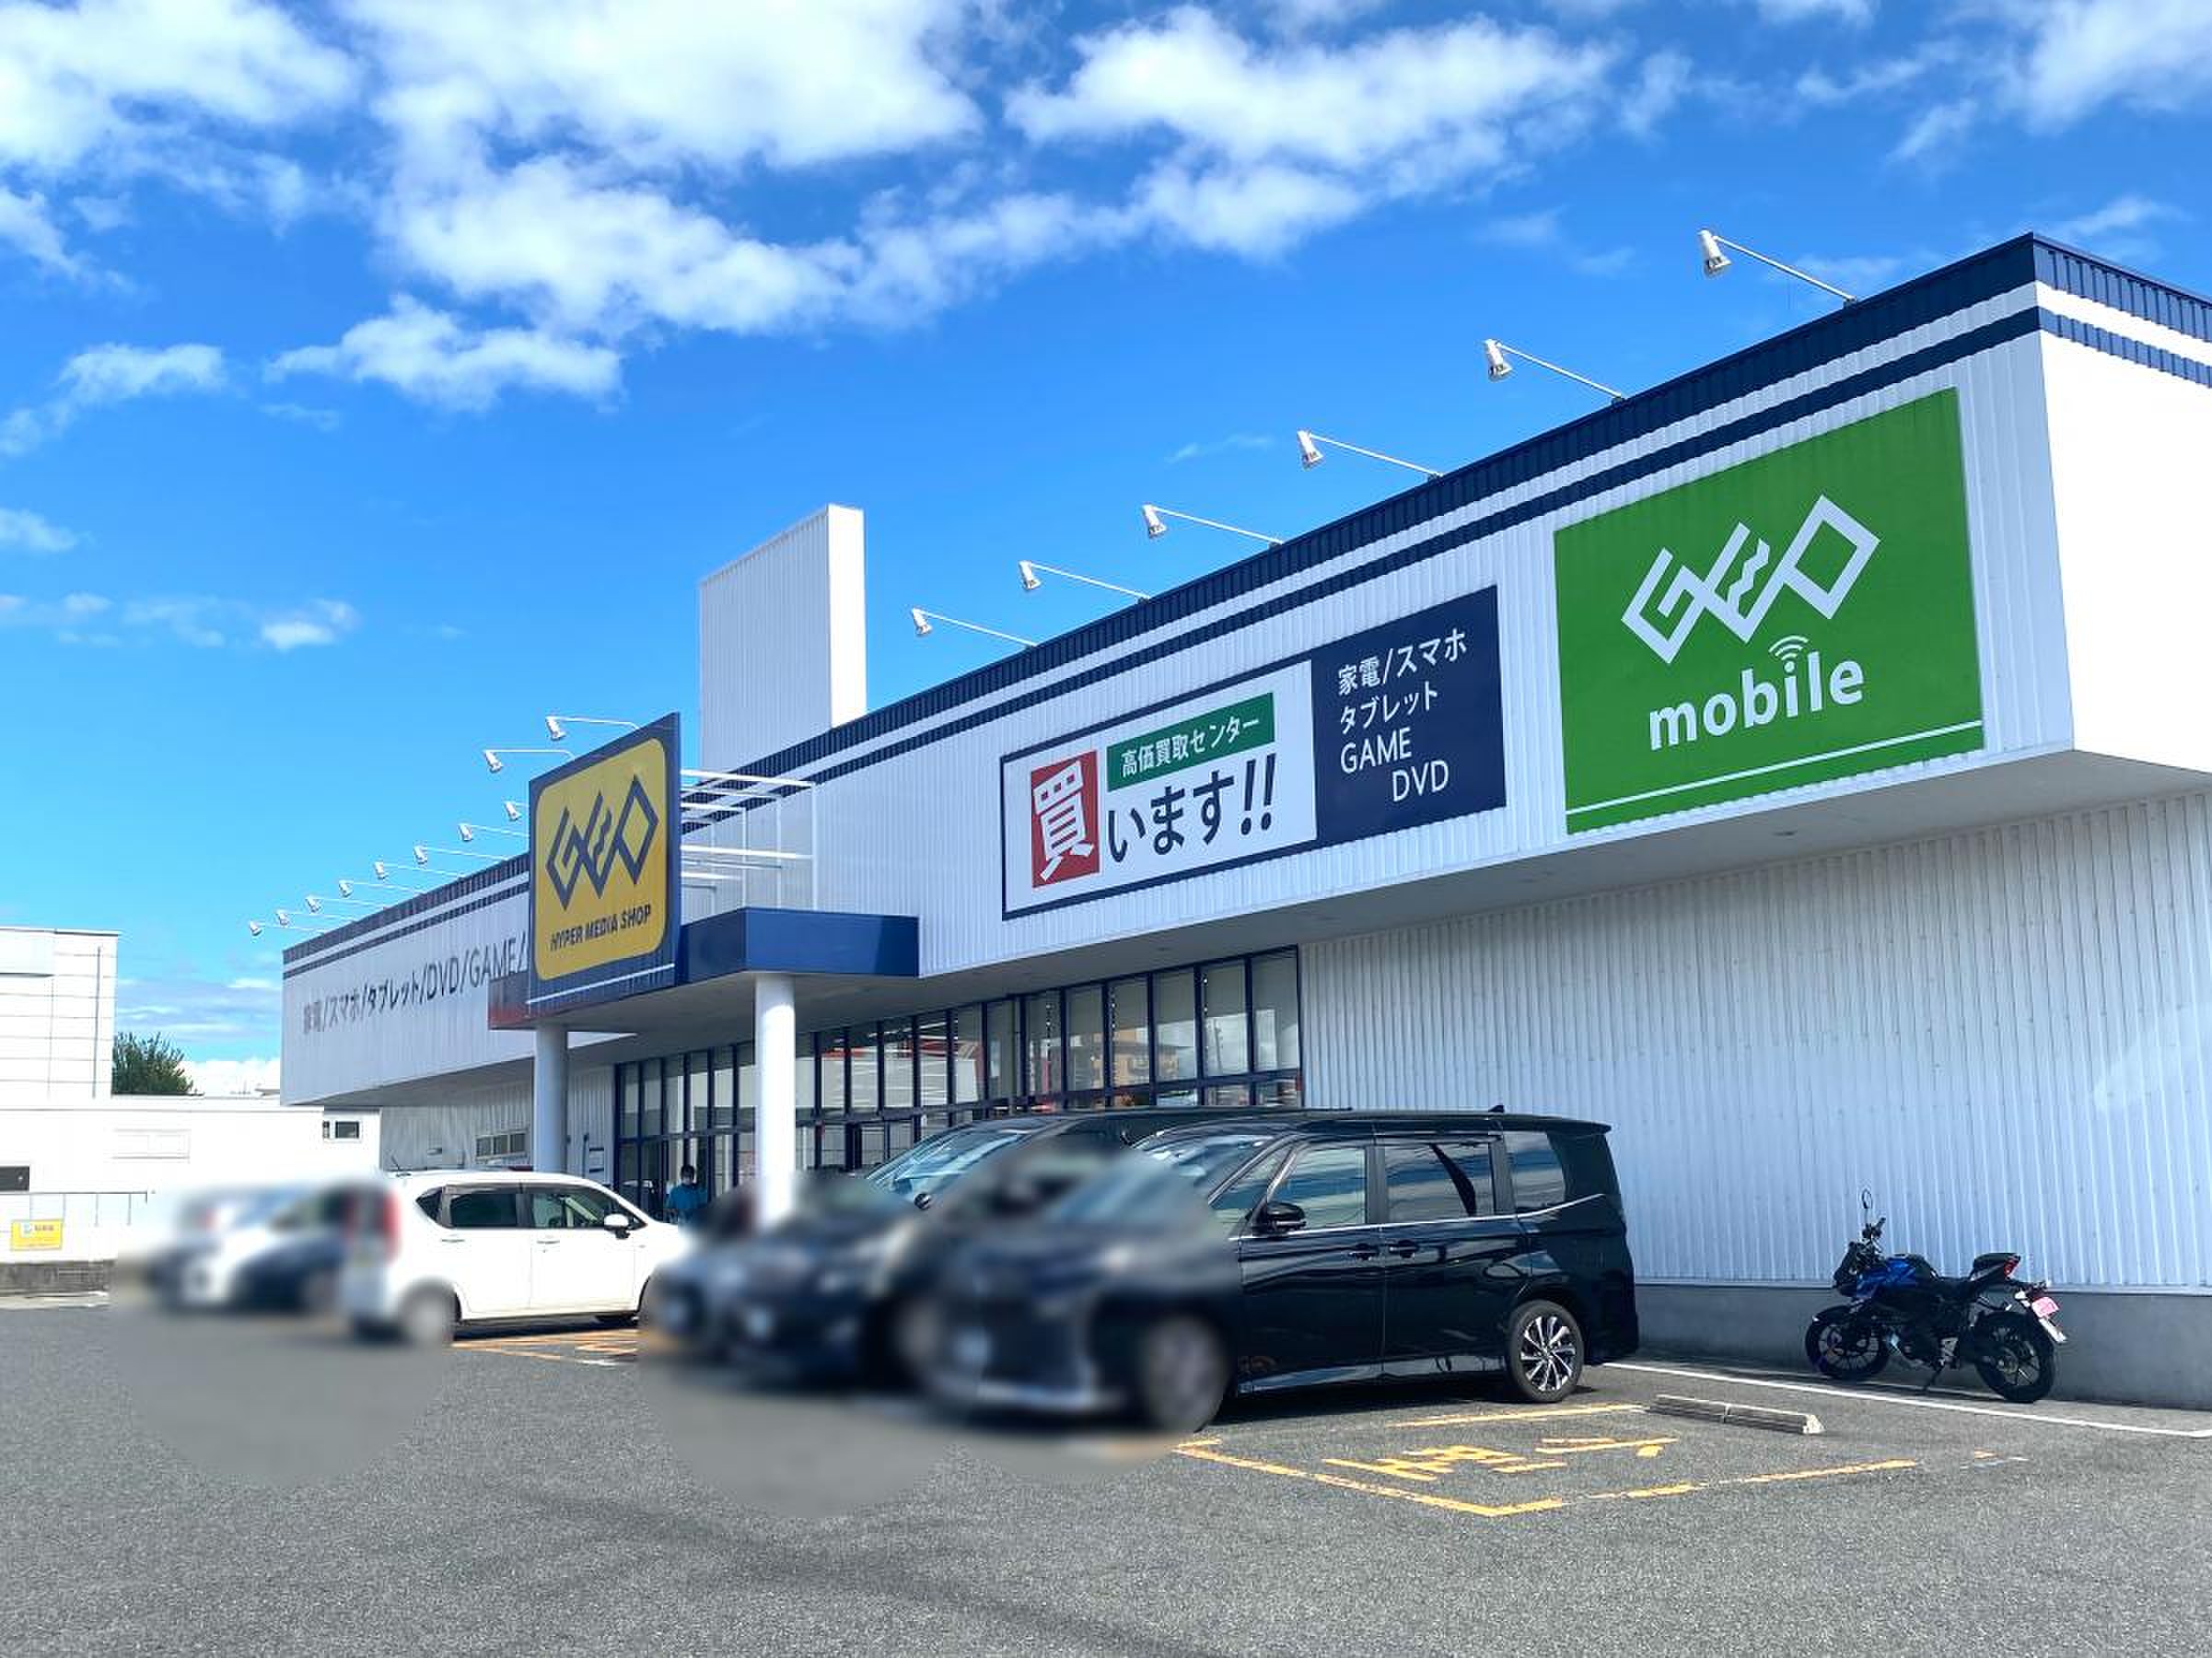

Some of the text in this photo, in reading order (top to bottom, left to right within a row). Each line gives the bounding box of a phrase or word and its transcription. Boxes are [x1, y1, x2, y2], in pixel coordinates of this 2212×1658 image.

[1338, 628, 1467, 696] 家電/スマホ
[1340, 681, 1438, 734] タブレット
[1649, 650, 1865, 751] mobile
[1120, 716, 1260, 777] 高価買取センター
[1340, 727, 1412, 774] GAME
[1392, 759, 1449, 801] DVD
[550, 903, 652, 952] HYPER MEDIA SHOP
